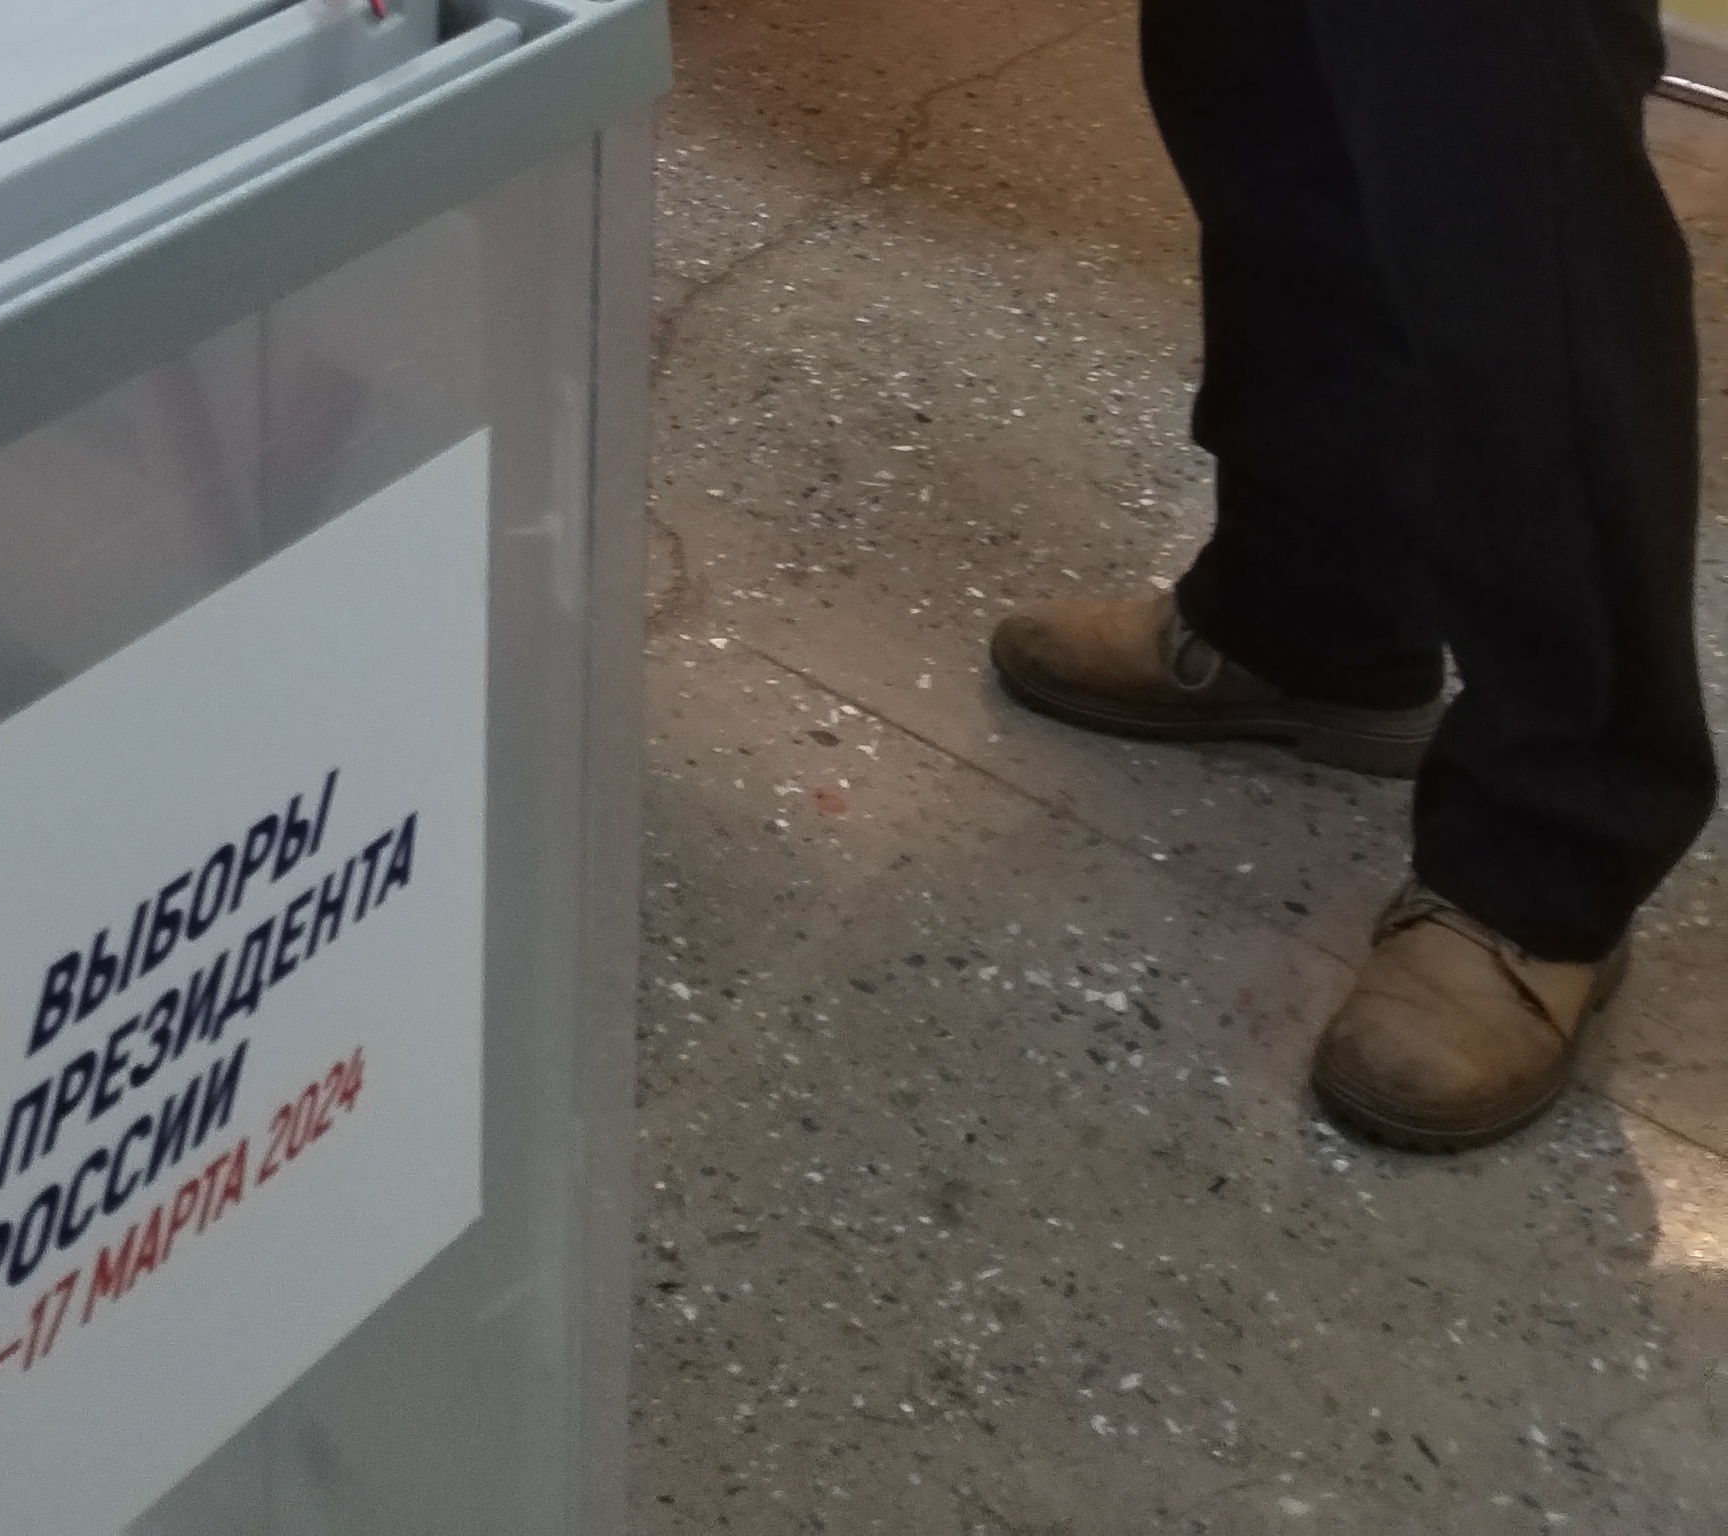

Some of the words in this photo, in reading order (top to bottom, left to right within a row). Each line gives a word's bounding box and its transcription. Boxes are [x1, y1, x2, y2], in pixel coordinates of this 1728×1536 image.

[23, 766, 339, 1059] ВЫБОРЫ
[79, 1134, 253, 1329] МАРТА
[255, 1045, 366, 1190] 2024
